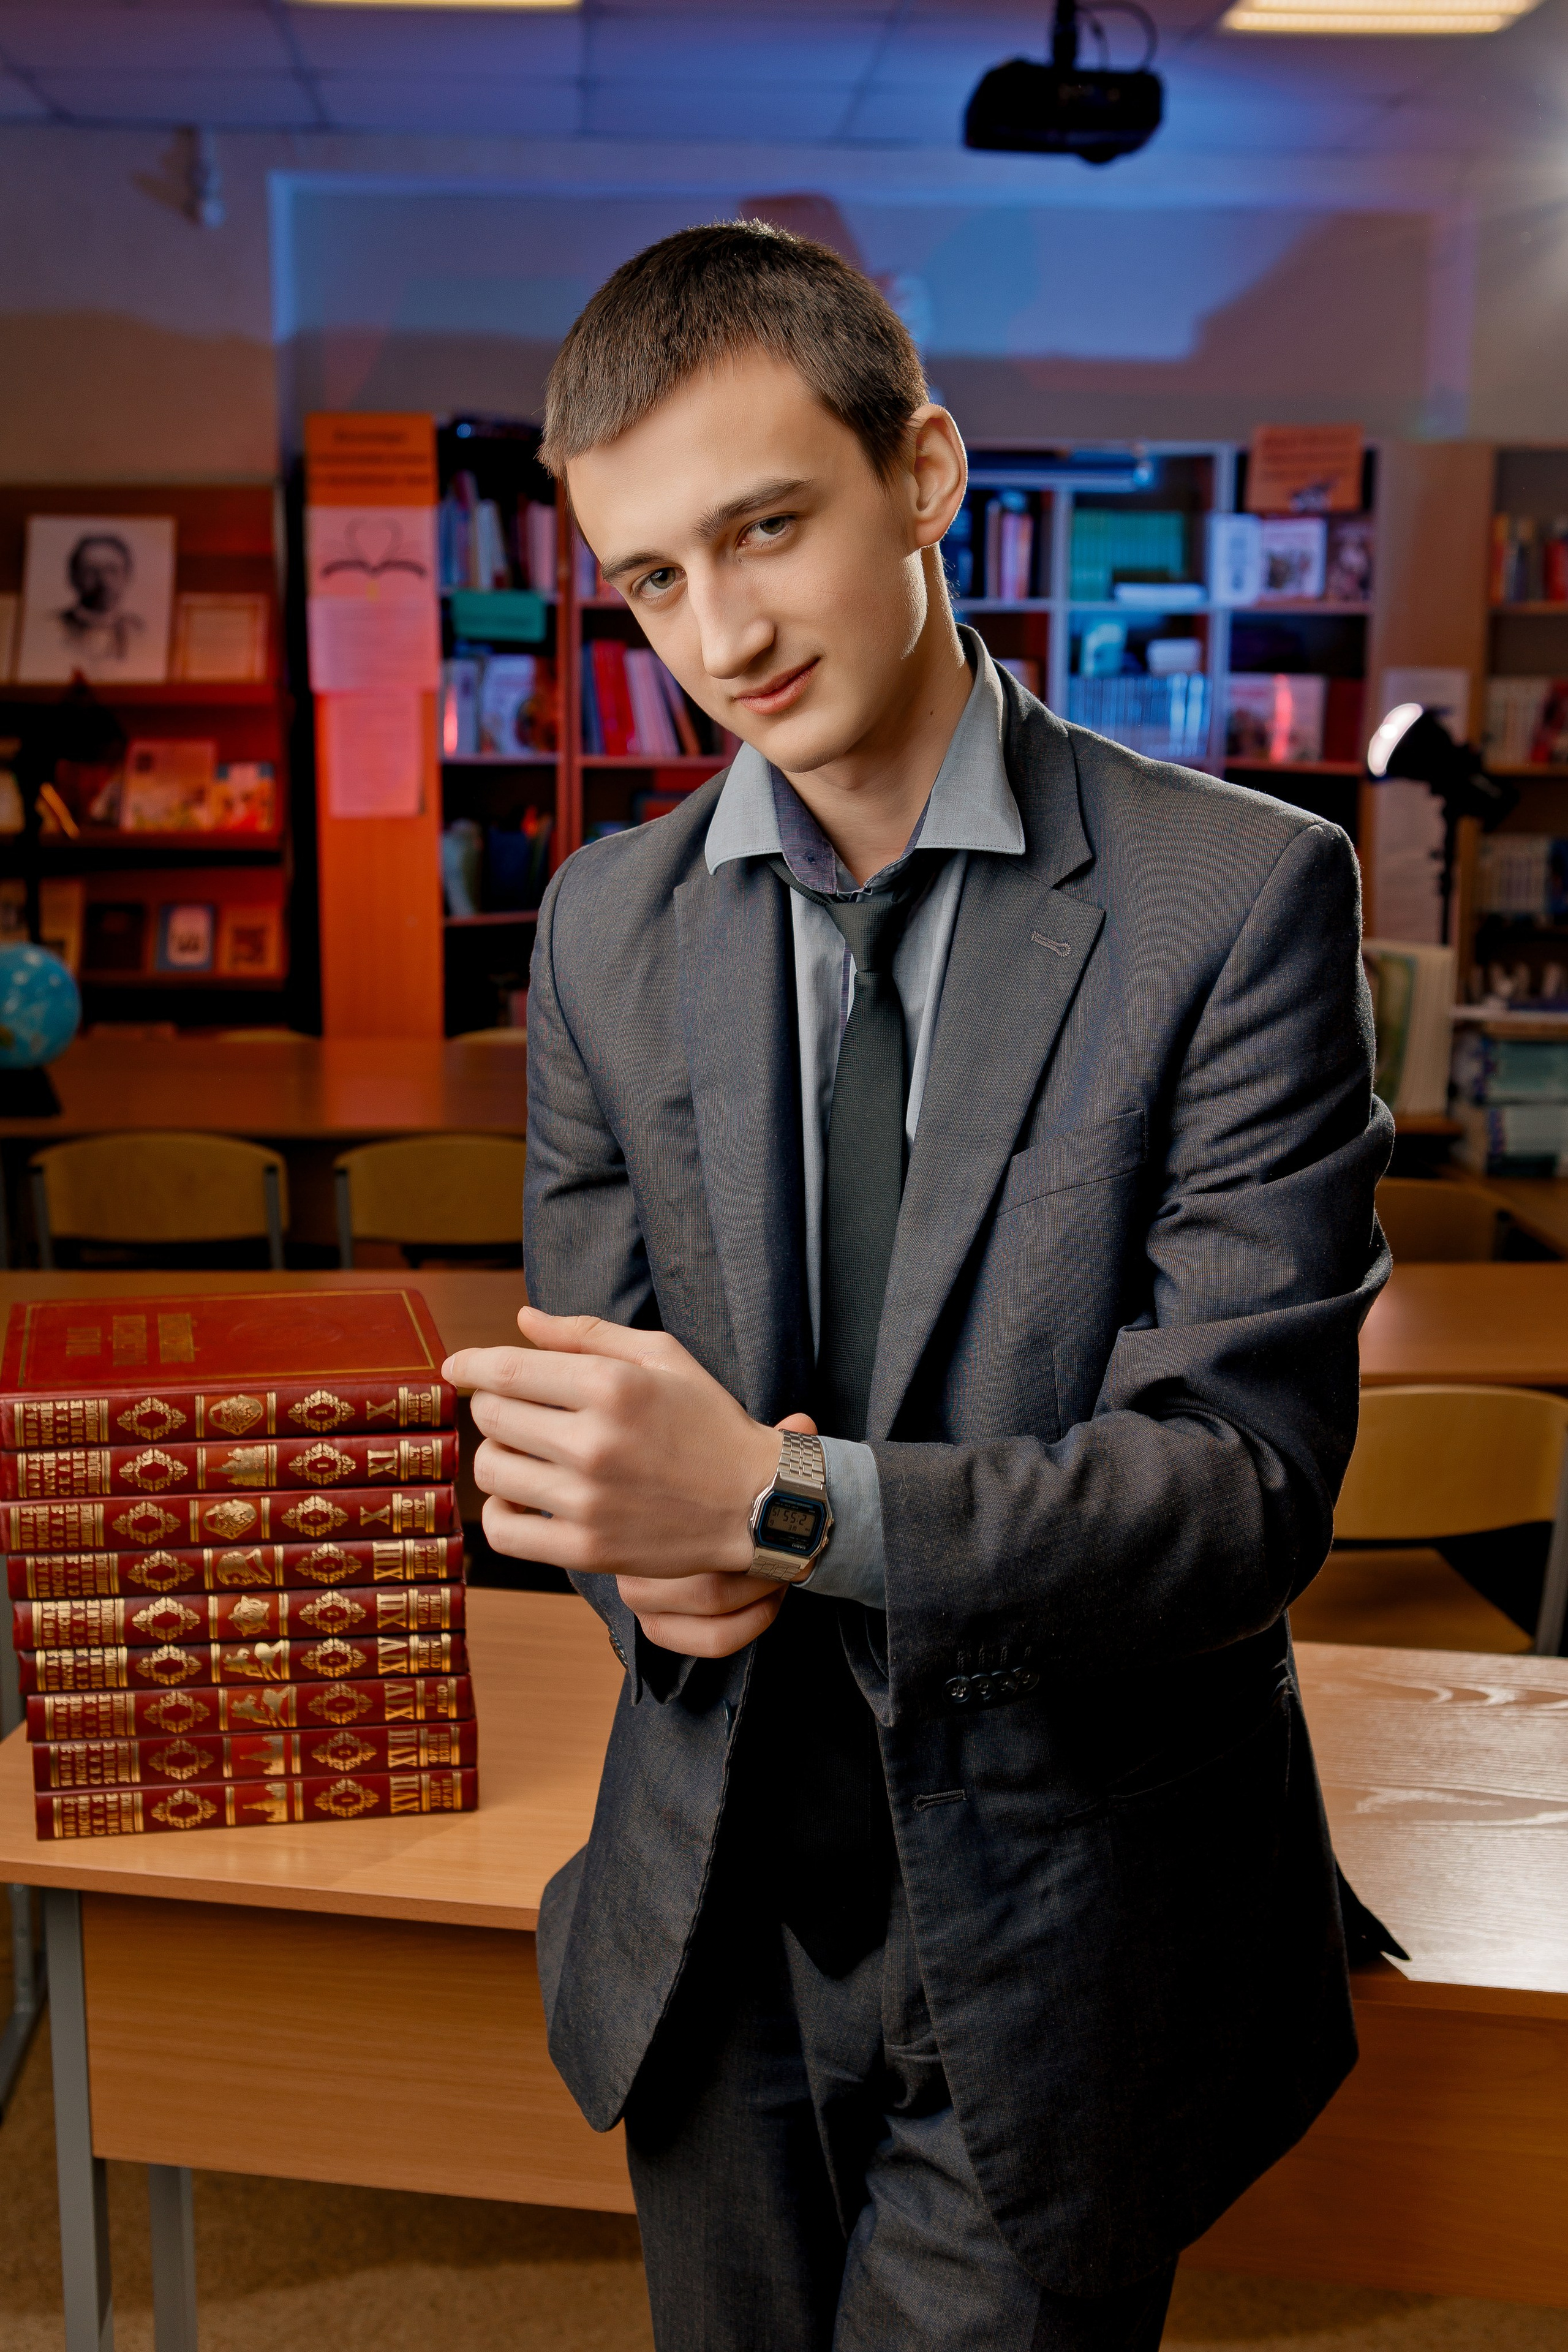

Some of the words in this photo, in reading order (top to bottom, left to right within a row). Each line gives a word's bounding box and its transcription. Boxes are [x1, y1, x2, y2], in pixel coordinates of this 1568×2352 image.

[55, 1400, 69, 1444] СКАЯ
[366, 1399, 396, 1421] X
[58, 1452, 71, 1495] СКАЯ
[367, 1448, 398, 1477] XI
[51, 1504, 64, 1548] СКАЯ
[360, 1504, 391, 1526] X
[402, 1498, 413, 1528] МАРО
[783, 1510, 807, 1526] 2:55
[372, 1541, 404, 1580] XIII
[72, 1600, 85, 1645] СКАЯ
[377, 1592, 407, 1629] XII
[75, 1648, 89, 1689] СКАЯ
[377, 1637, 408, 1675] XIV
[384, 1681, 415, 1721] XIV
[388, 1728, 418, 1768] XVII
[390, 1773, 420, 1814] XVII
[92, 1794, 106, 1834] СКАЯ
